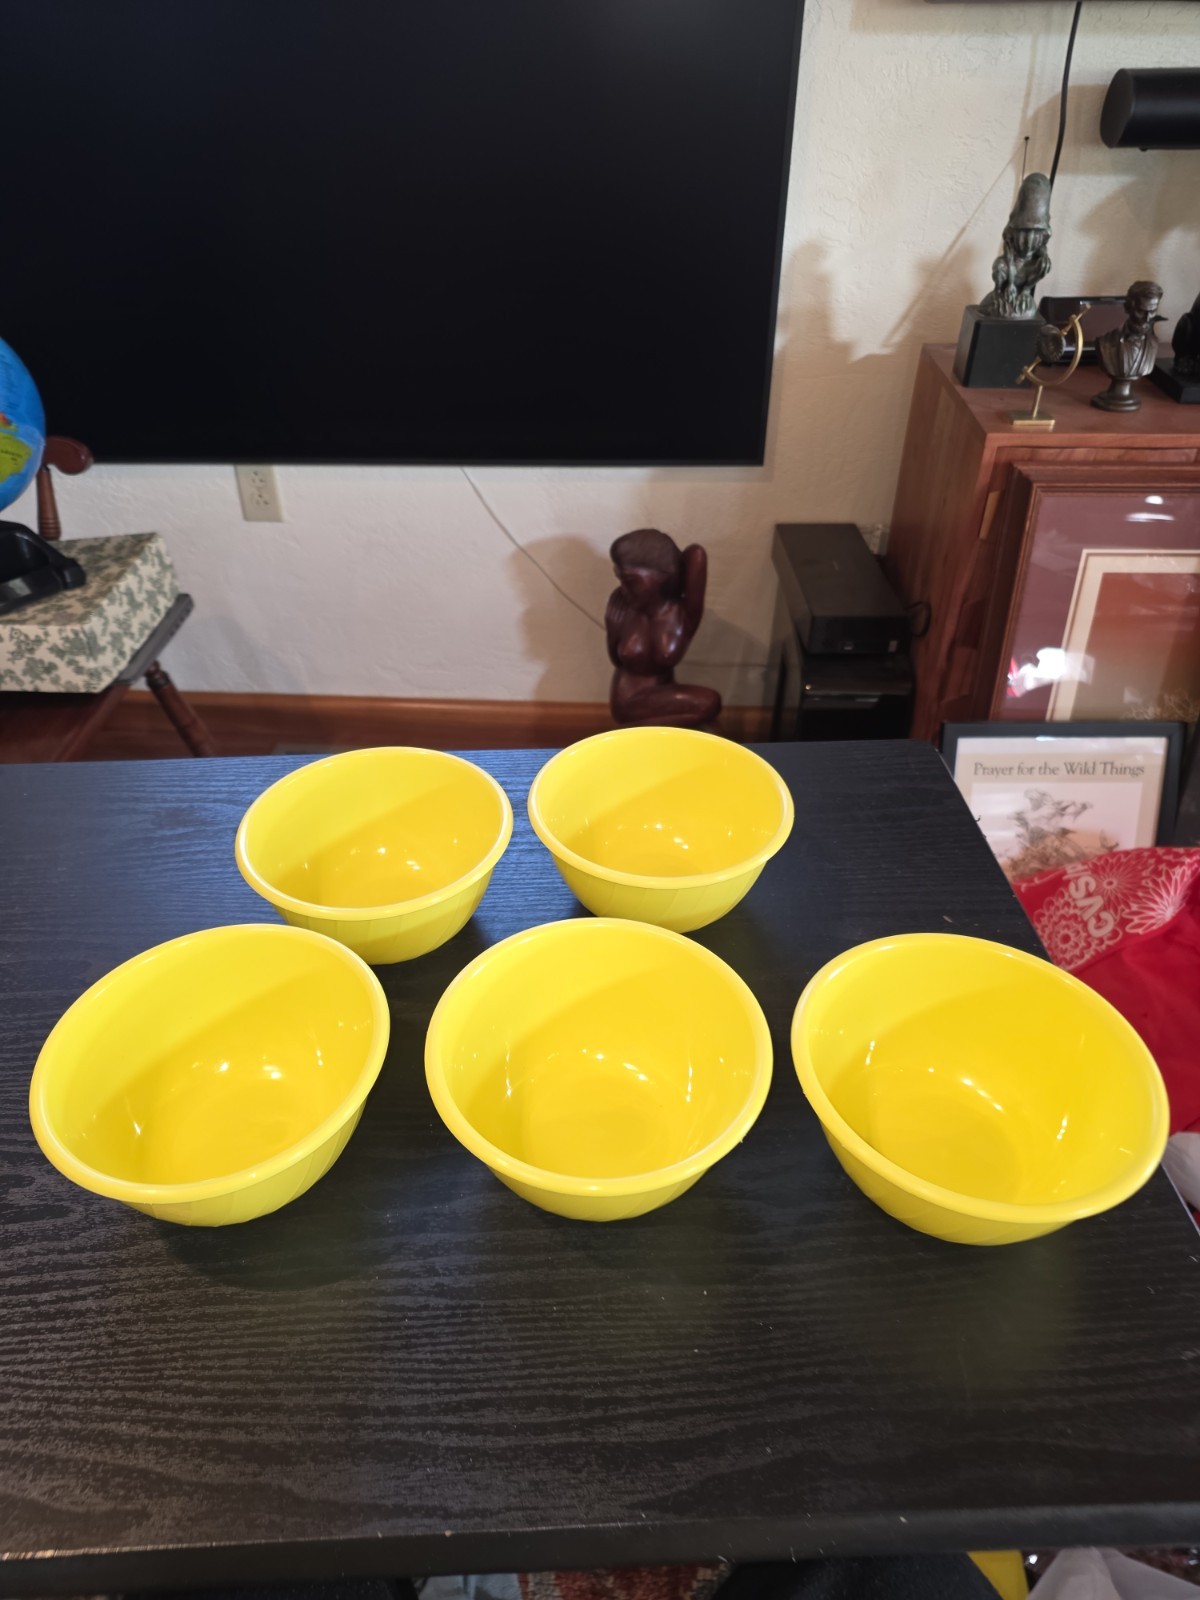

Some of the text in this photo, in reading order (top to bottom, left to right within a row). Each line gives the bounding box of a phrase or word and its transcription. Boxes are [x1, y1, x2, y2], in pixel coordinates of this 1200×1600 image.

[973, 761, 1145, 779] Prayer for the Wild Things
